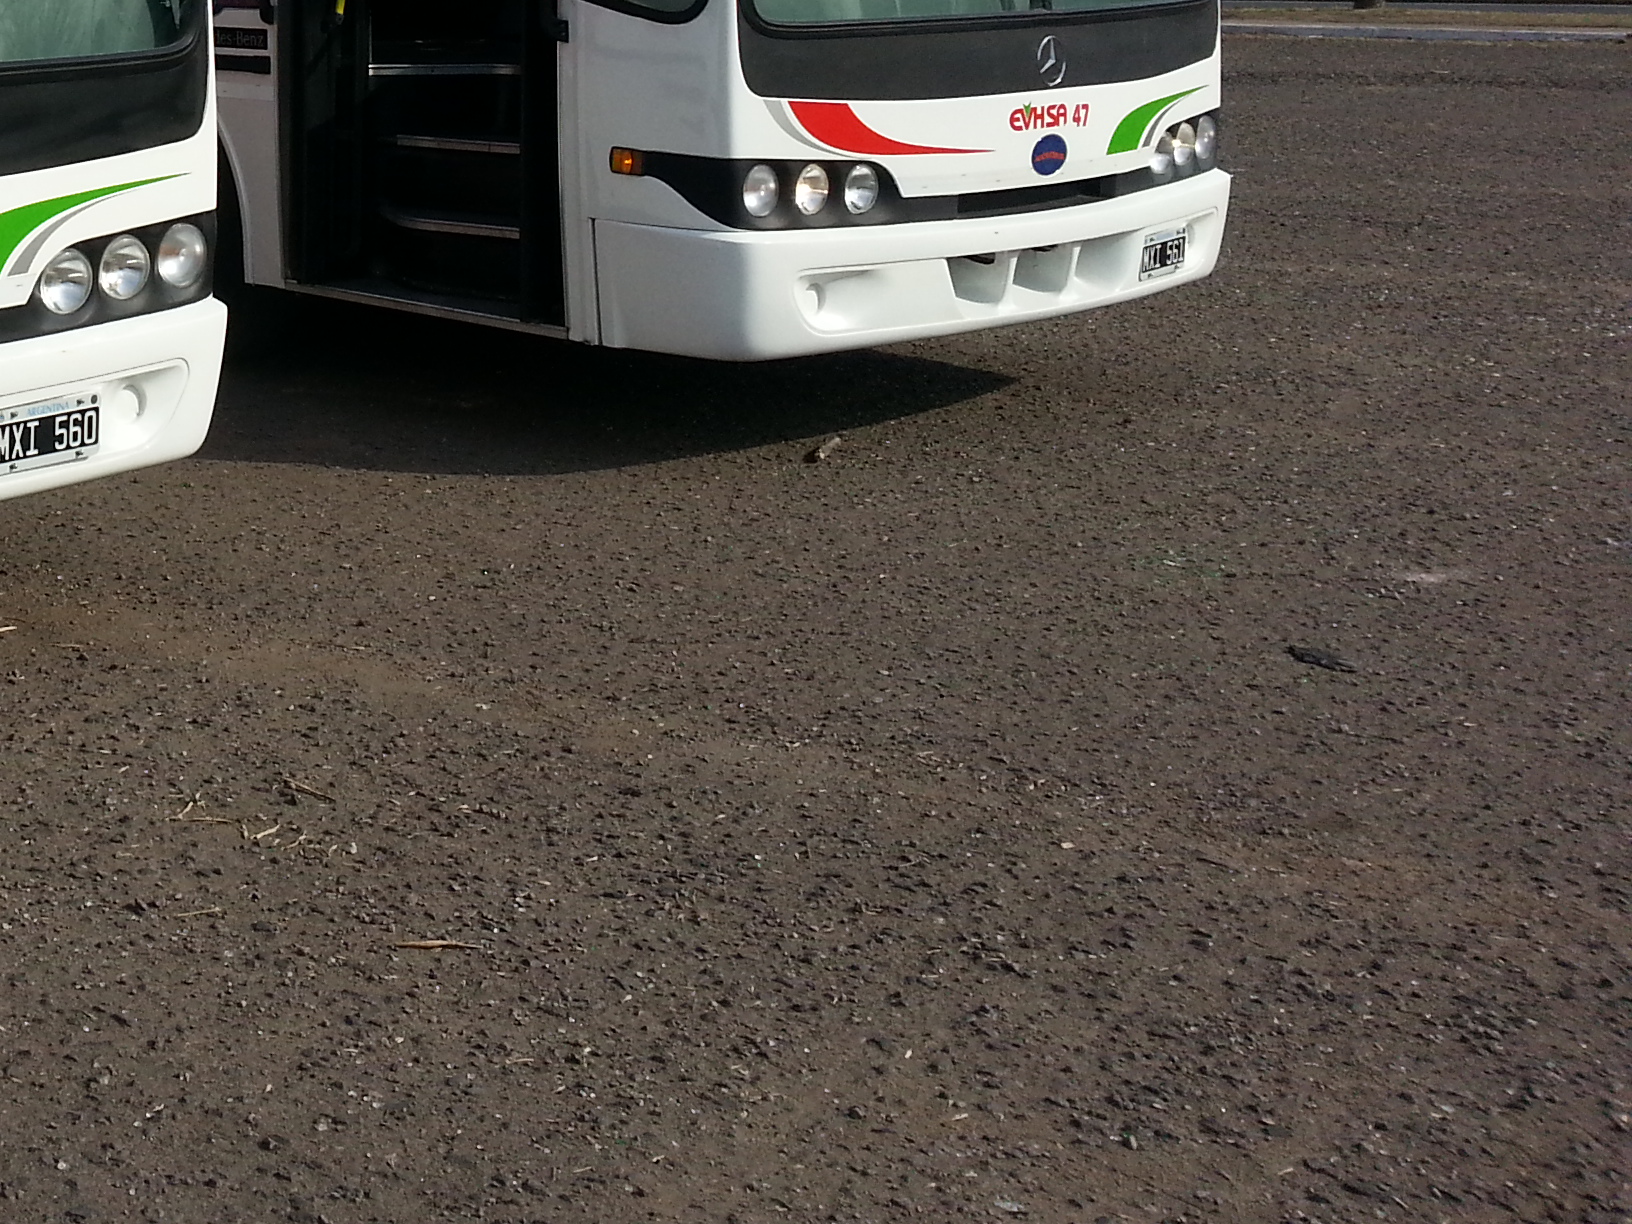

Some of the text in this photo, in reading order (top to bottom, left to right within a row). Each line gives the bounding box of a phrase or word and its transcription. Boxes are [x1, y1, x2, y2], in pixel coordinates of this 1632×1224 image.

[1009, 101, 1089, 131] EVHSA 47
[1142, 238, 1184, 272] MXI 561
[27, 401, 69, 416] ARGENTINA
[54, 410, 97, 450] 560
